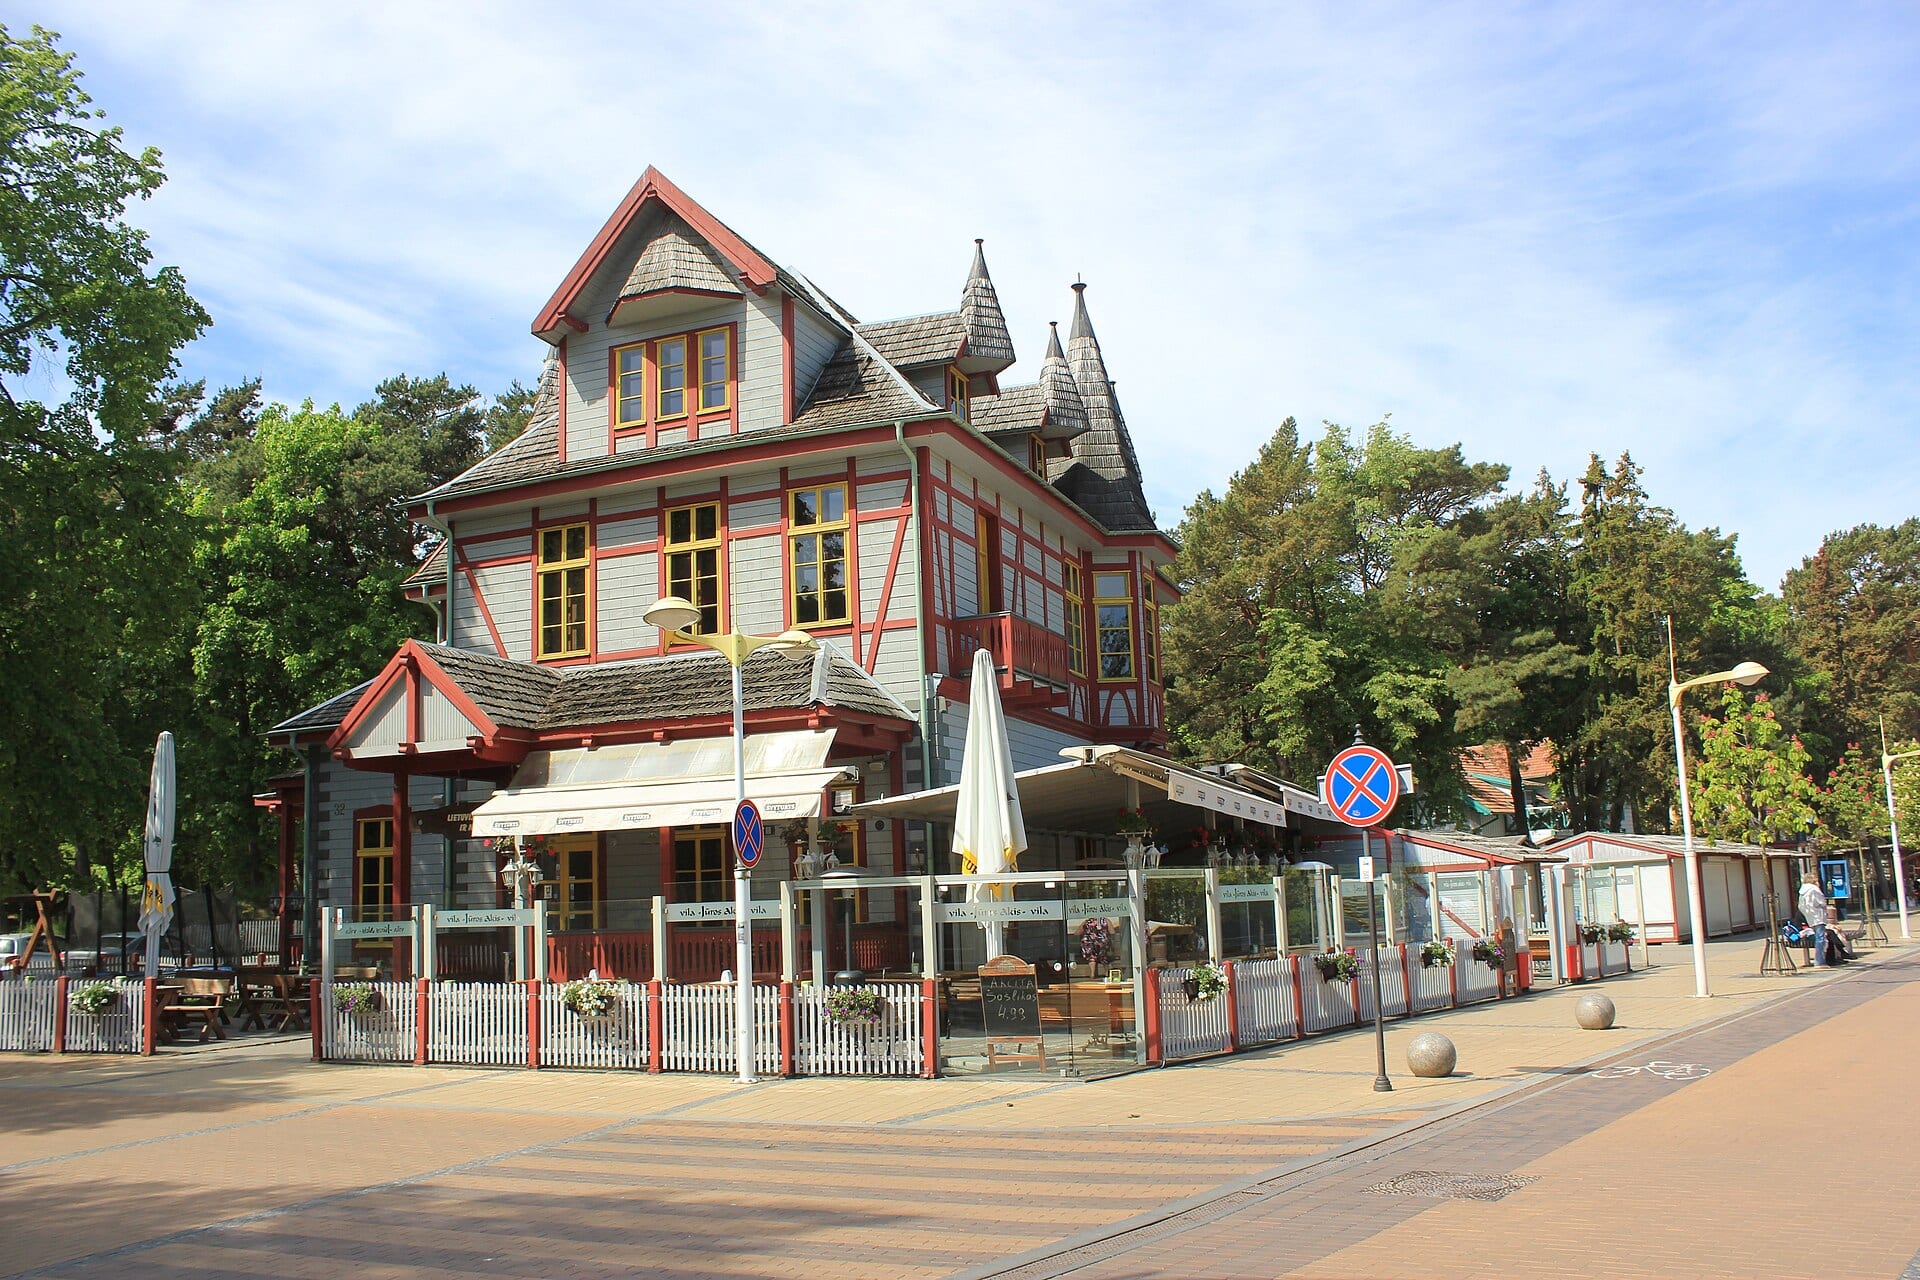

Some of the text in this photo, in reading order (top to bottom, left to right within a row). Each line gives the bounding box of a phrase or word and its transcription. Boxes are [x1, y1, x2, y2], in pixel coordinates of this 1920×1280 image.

[334, 803, 345, 816] 32
[447, 813, 473, 822] LIETUVI
[680, 907, 695, 917] vila
[750, 905, 767, 914] vila
[949, 907, 967, 917] vila
[1030, 905, 1049, 915] vila
[446, 914, 460, 923] vila
[998, 1004, 1026, 1020] 4.99
